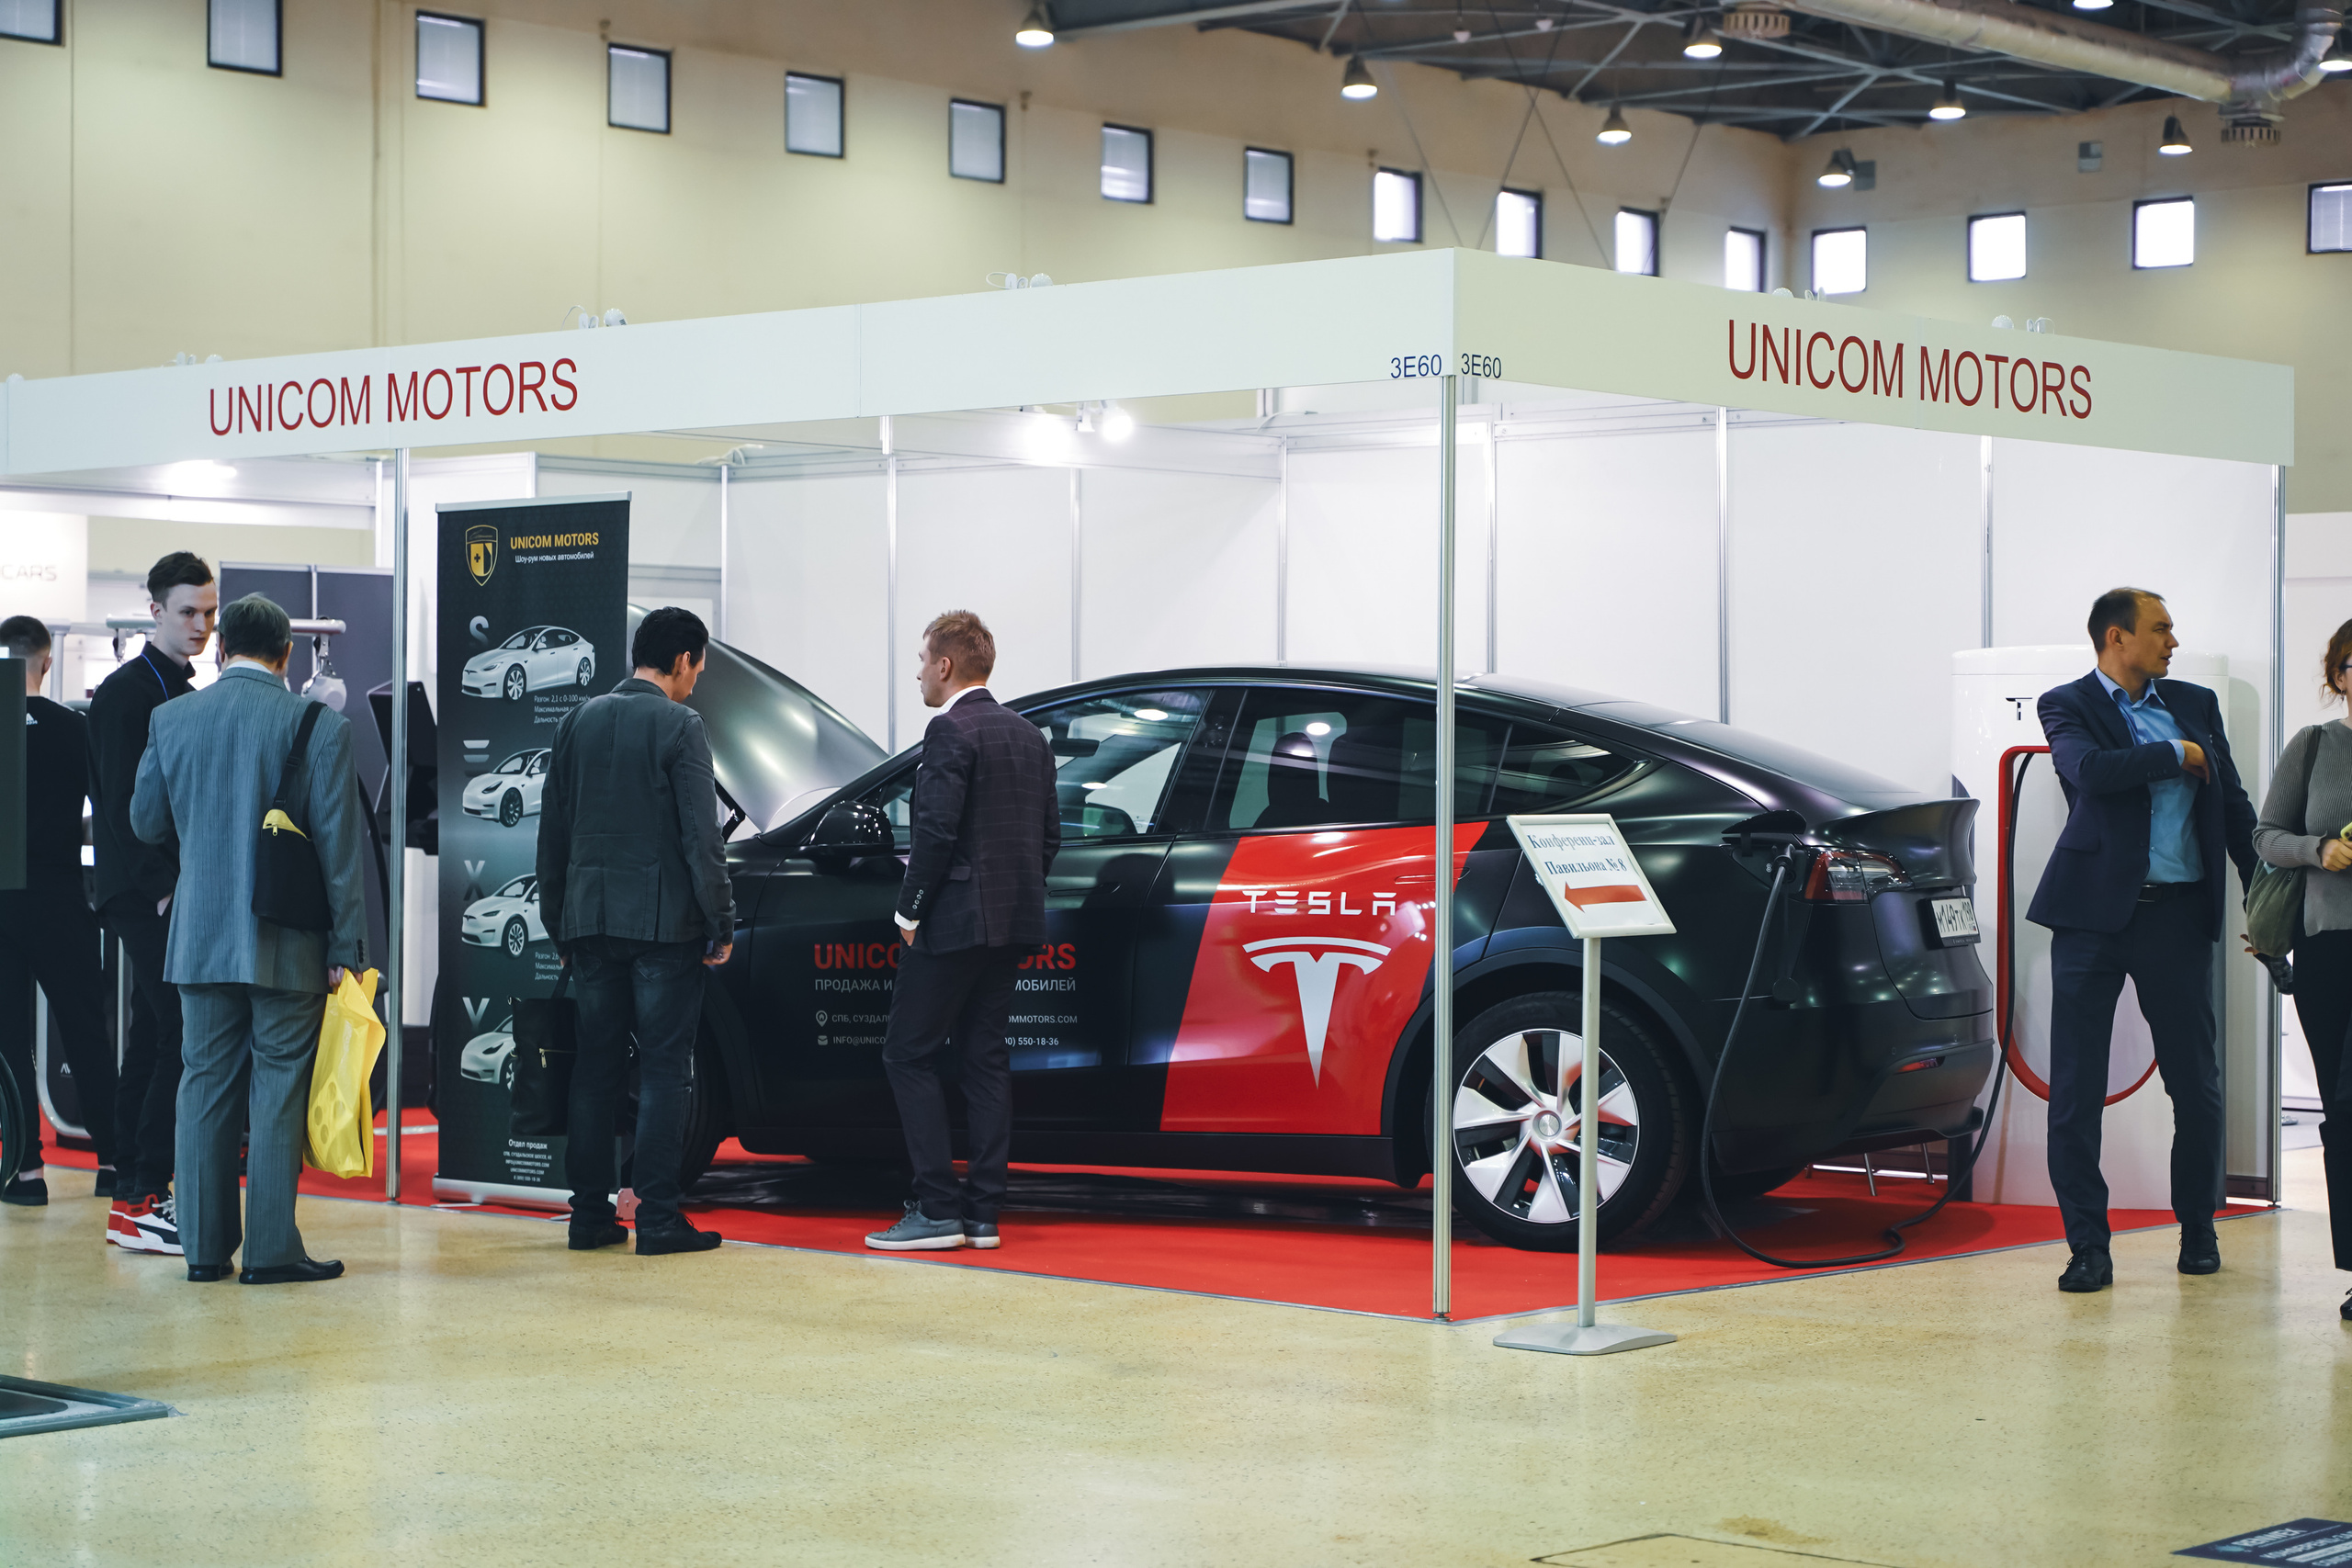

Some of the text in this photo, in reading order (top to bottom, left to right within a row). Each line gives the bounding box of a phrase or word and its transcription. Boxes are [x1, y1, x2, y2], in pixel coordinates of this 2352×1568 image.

[1390, 354, 1442, 379] 3E60
[1461, 353, 1502, 379] 3E60
[1728, 319, 2093, 420] UNICOM MOTORS
[209, 357, 579, 436] UNICOM MOTORS
[510, 532, 599, 550] UNICOM MOTORS
[514, 550, 594, 565] Шоу-рум новых автомобилей
[563, 694, 579, 703] 0-100
[534, 705, 570, 714] Максимальная
[533, 715, 559, 724] Дальность
[1526, 833, 1616, 852] Конференц-зал
[1544, 861, 1607, 875] Павильона
[1242, 890, 1397, 916] TESLA
[814, 942, 901, 970] UNICO
[815, 979, 881, 993] ПРОДАЖА
[883, 979, 893, 991] И
[831, 1014, 852, 1024] СПБ,
[832, 1035, 887, 1046] INFO@UNICO
[1017, 1036, 1059, 1046] 550-18-36
[508, 1139, 548, 1150] Отдел продаж
